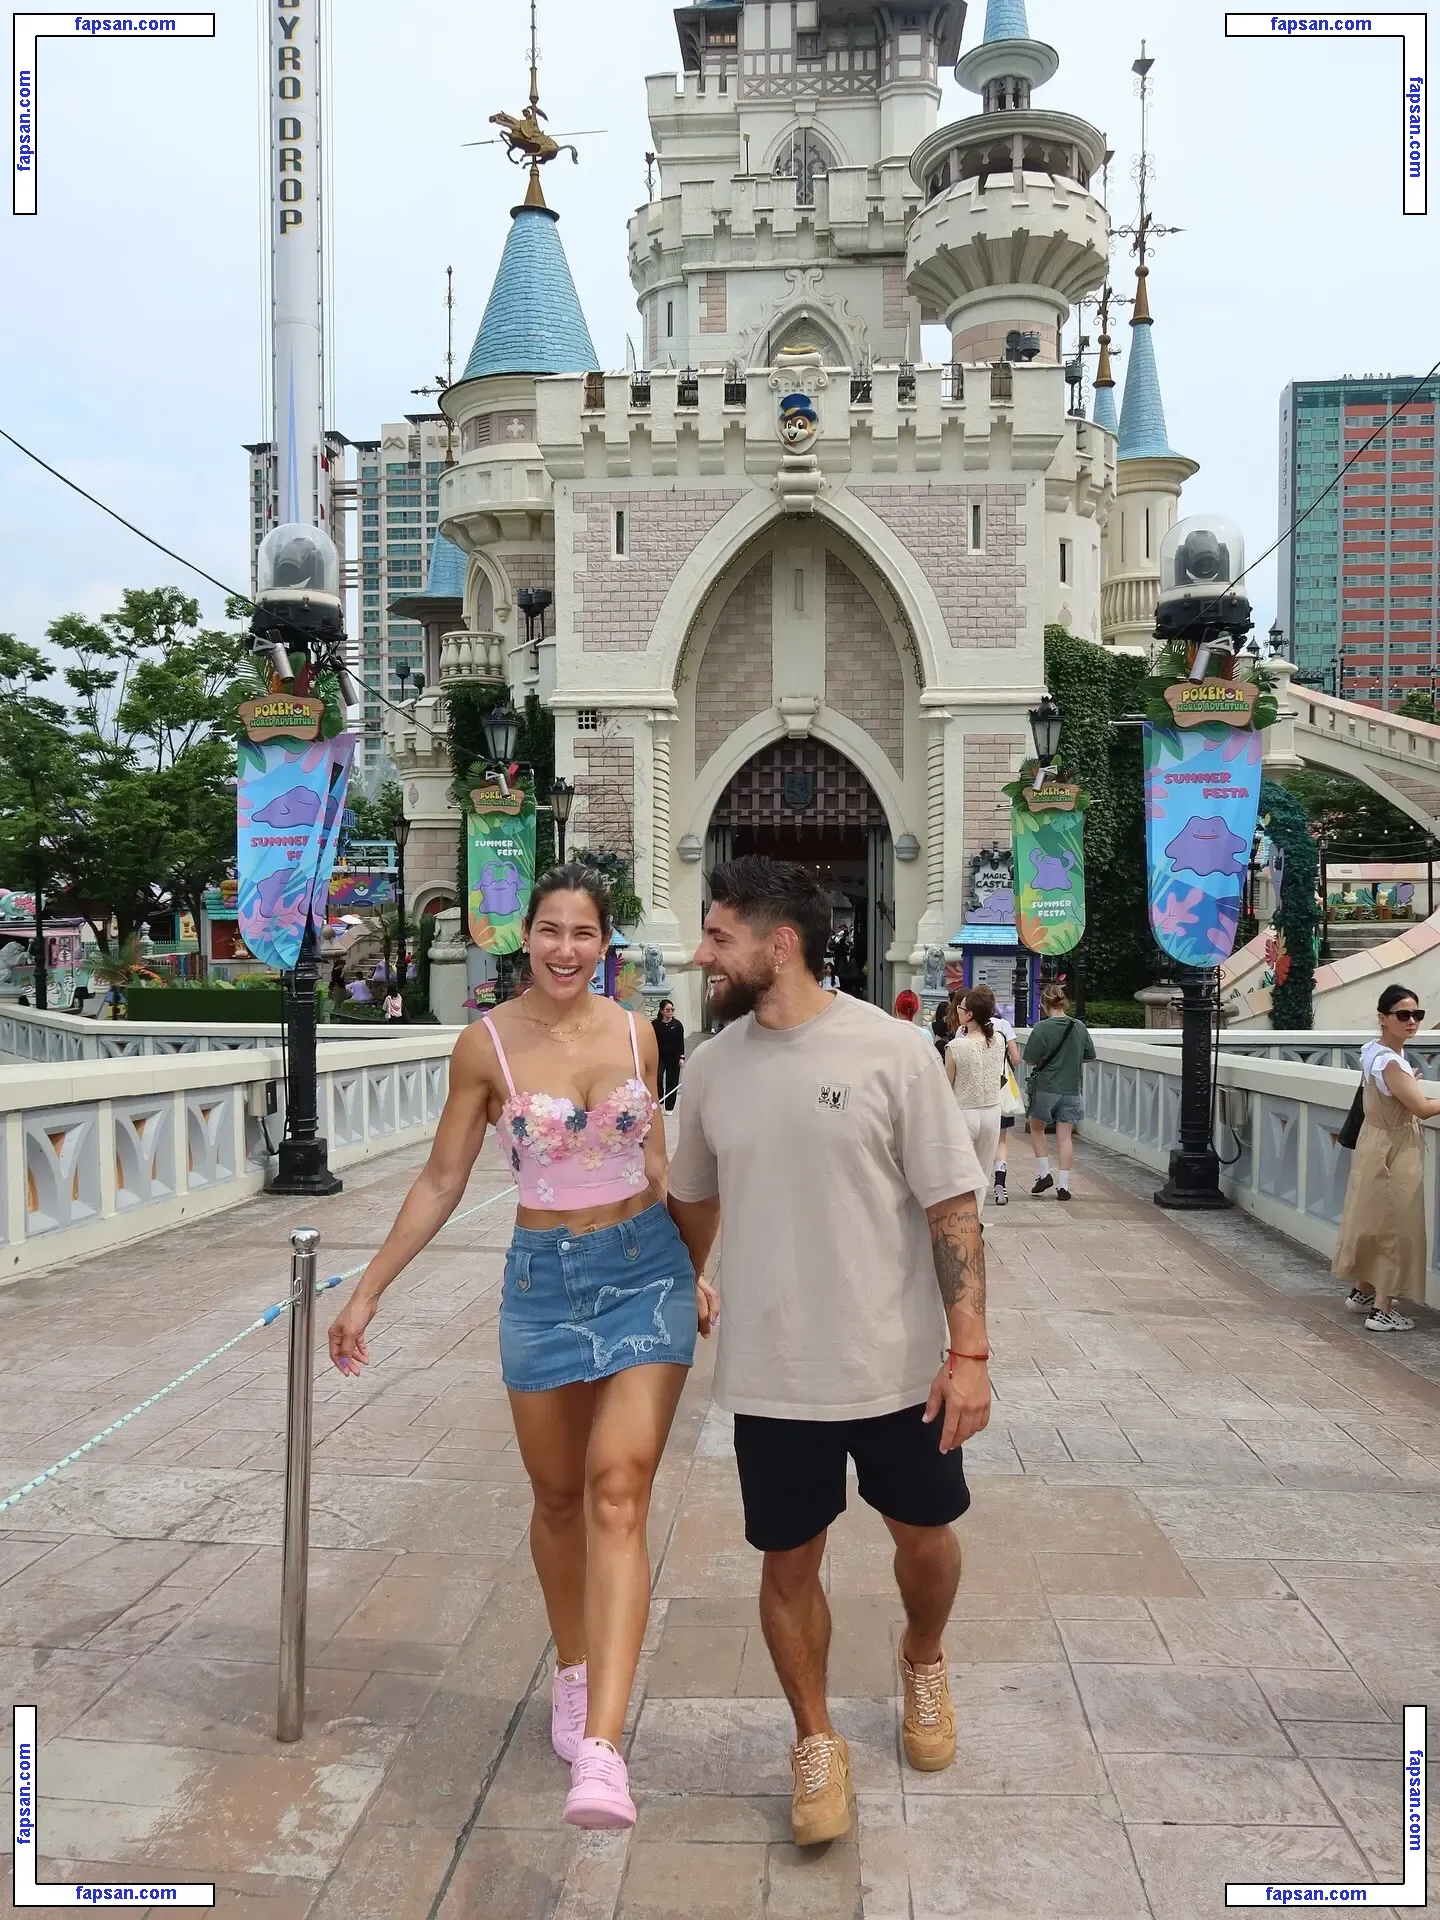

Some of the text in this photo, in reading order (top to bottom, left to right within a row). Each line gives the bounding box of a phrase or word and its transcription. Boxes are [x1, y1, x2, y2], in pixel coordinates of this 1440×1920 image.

[278, 116, 305, 237] DROP
[1203, 702, 1250, 712] ADVENTURE
[275, 717, 316, 727] ADVENTURE
[1164, 772, 1232, 785] SUMMER
[1202, 787, 1249, 799] FESTA
[982, 872, 1007, 880] MAGIC
[975, 880, 1013, 889] CASTLE
[1031, 900, 1072, 908] SUMMER
[1038, 909, 1066, 917] FESTA
